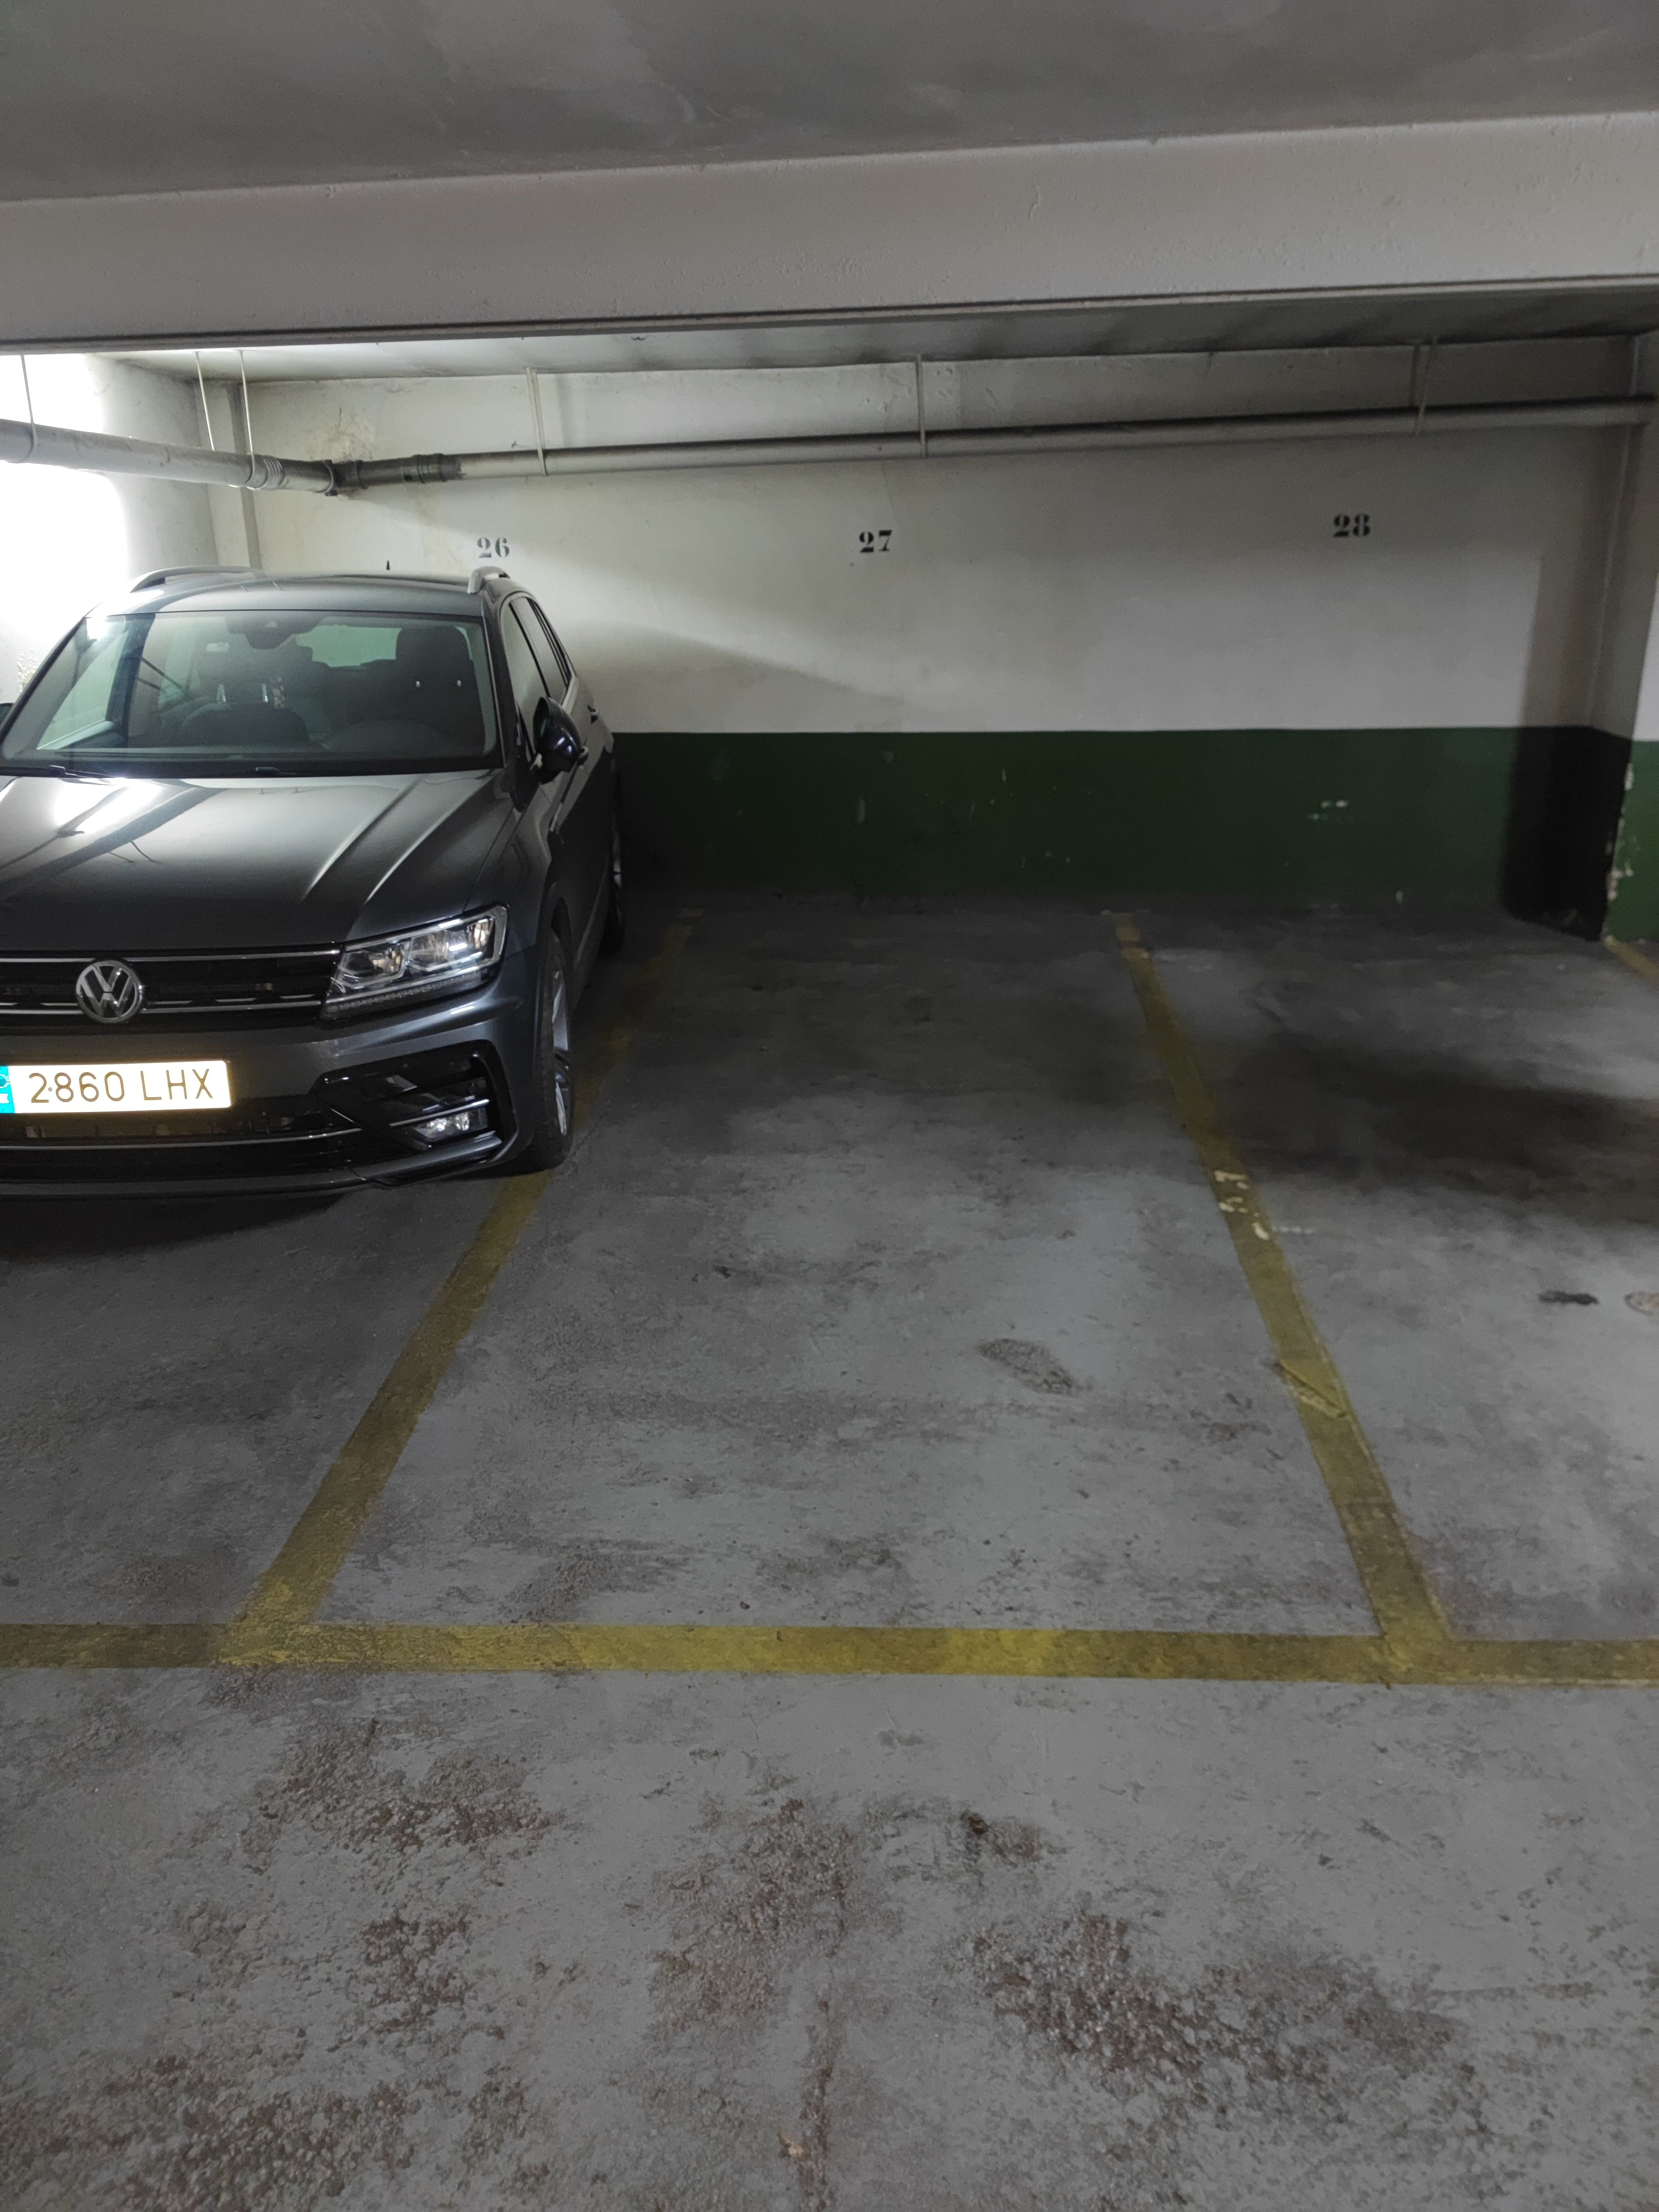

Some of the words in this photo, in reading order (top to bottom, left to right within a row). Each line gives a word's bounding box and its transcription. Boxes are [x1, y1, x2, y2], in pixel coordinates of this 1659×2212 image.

[1333, 514, 1370, 538] 28
[477, 537, 510, 558] 26
[859, 529, 892, 553] 27
[29, 1071, 125, 1103] 2860
[140, 1068, 213, 1100] LHX
